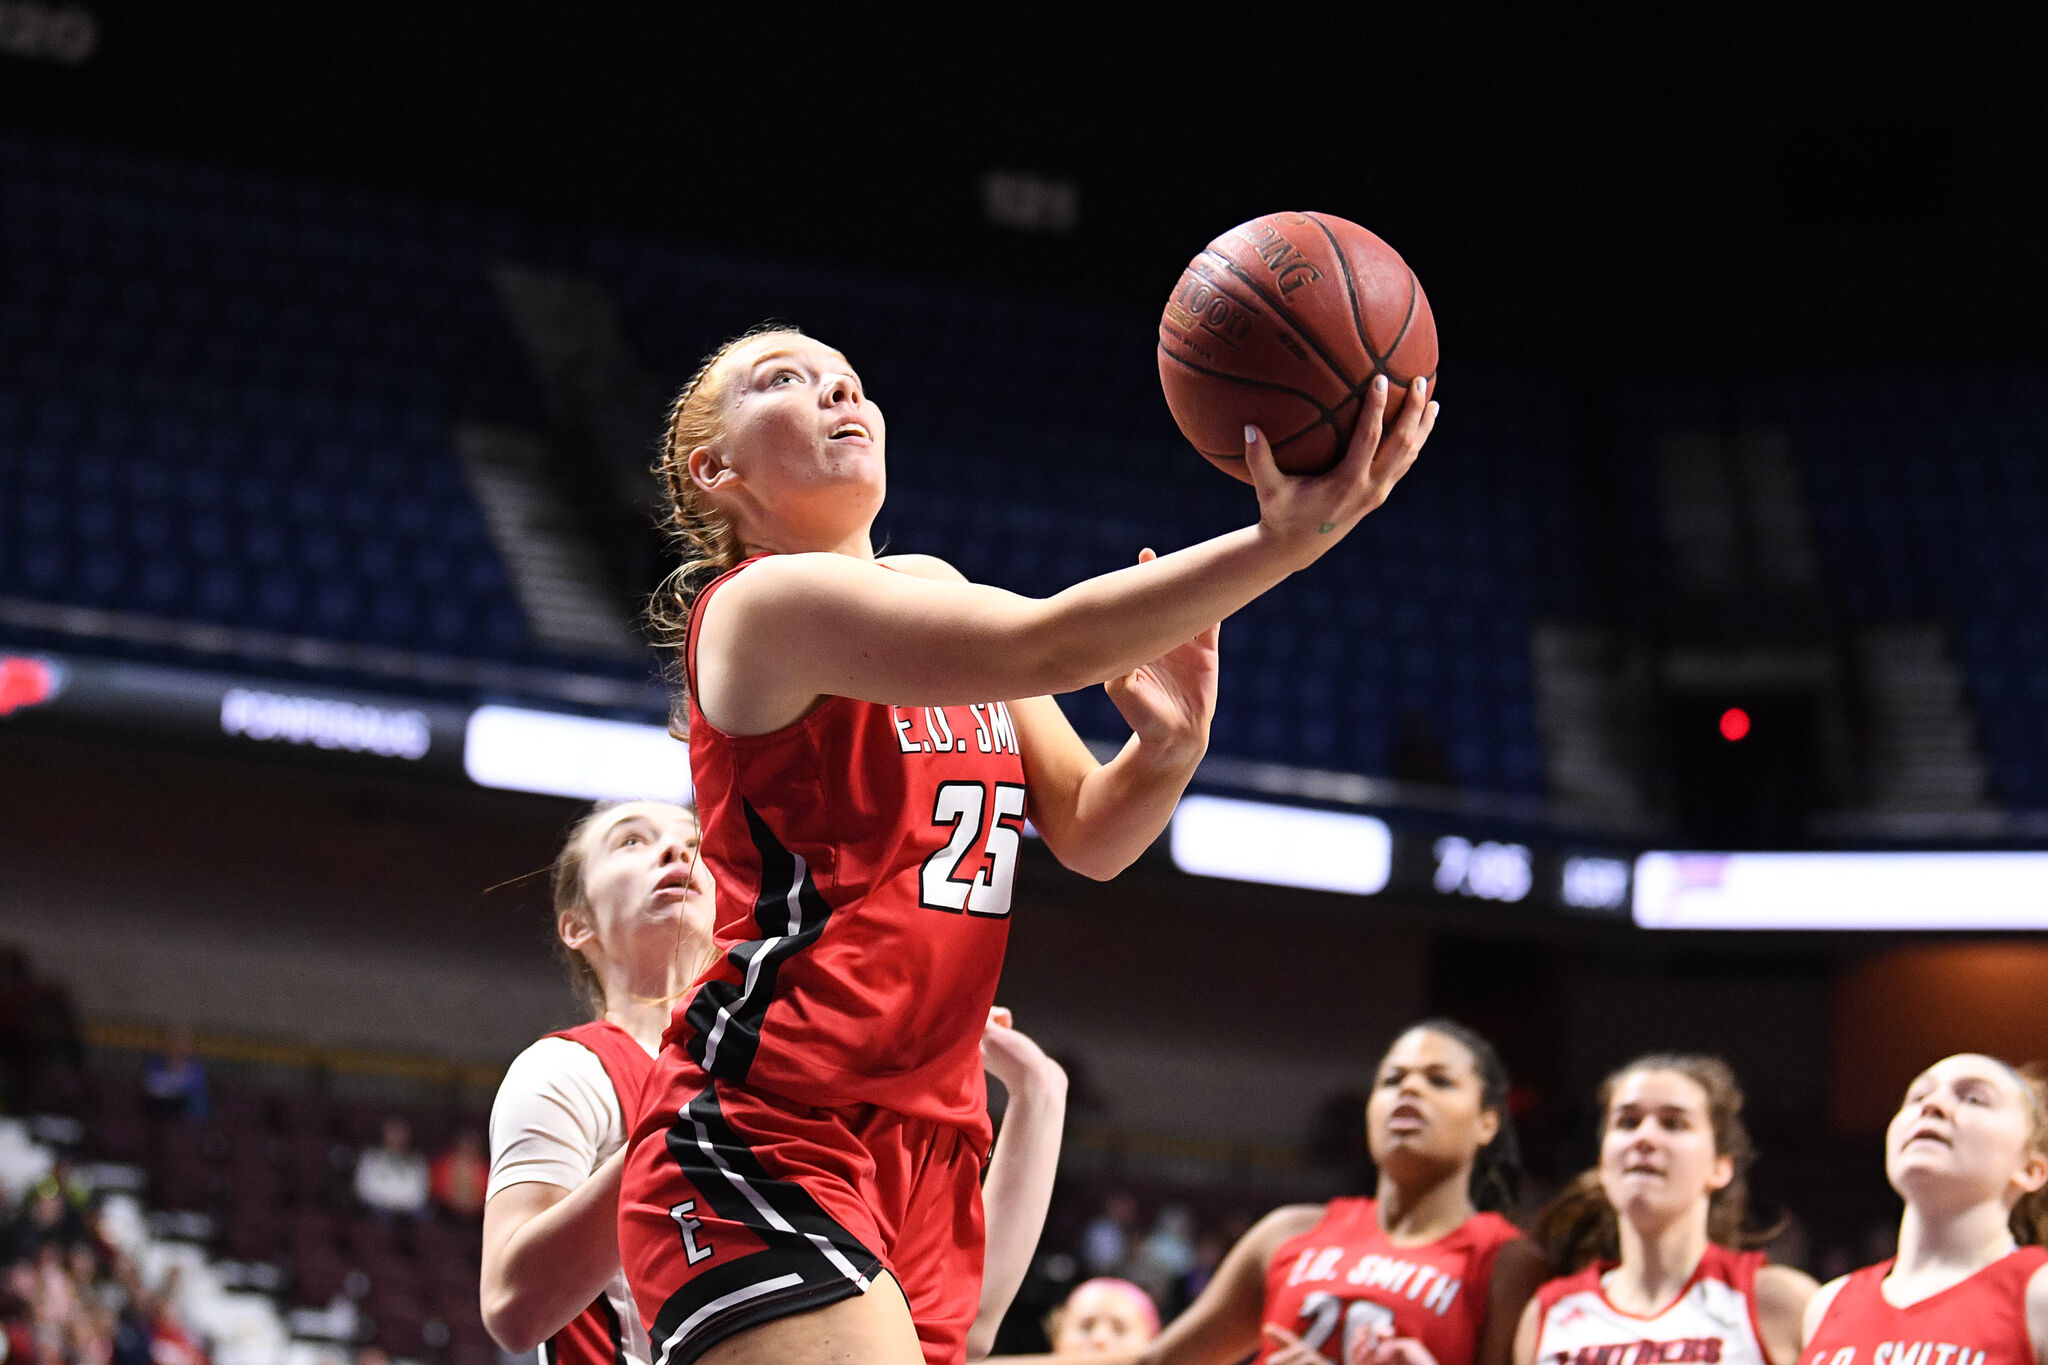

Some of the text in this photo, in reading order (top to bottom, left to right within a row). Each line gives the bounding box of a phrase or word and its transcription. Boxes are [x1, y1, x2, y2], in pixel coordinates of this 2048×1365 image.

[918, 780, 1026, 919] 25
[669, 1198, 714, 1267] E
[1346, 1253, 1461, 1316] SMITH
[1872, 1340, 1988, 1365] SMITH
